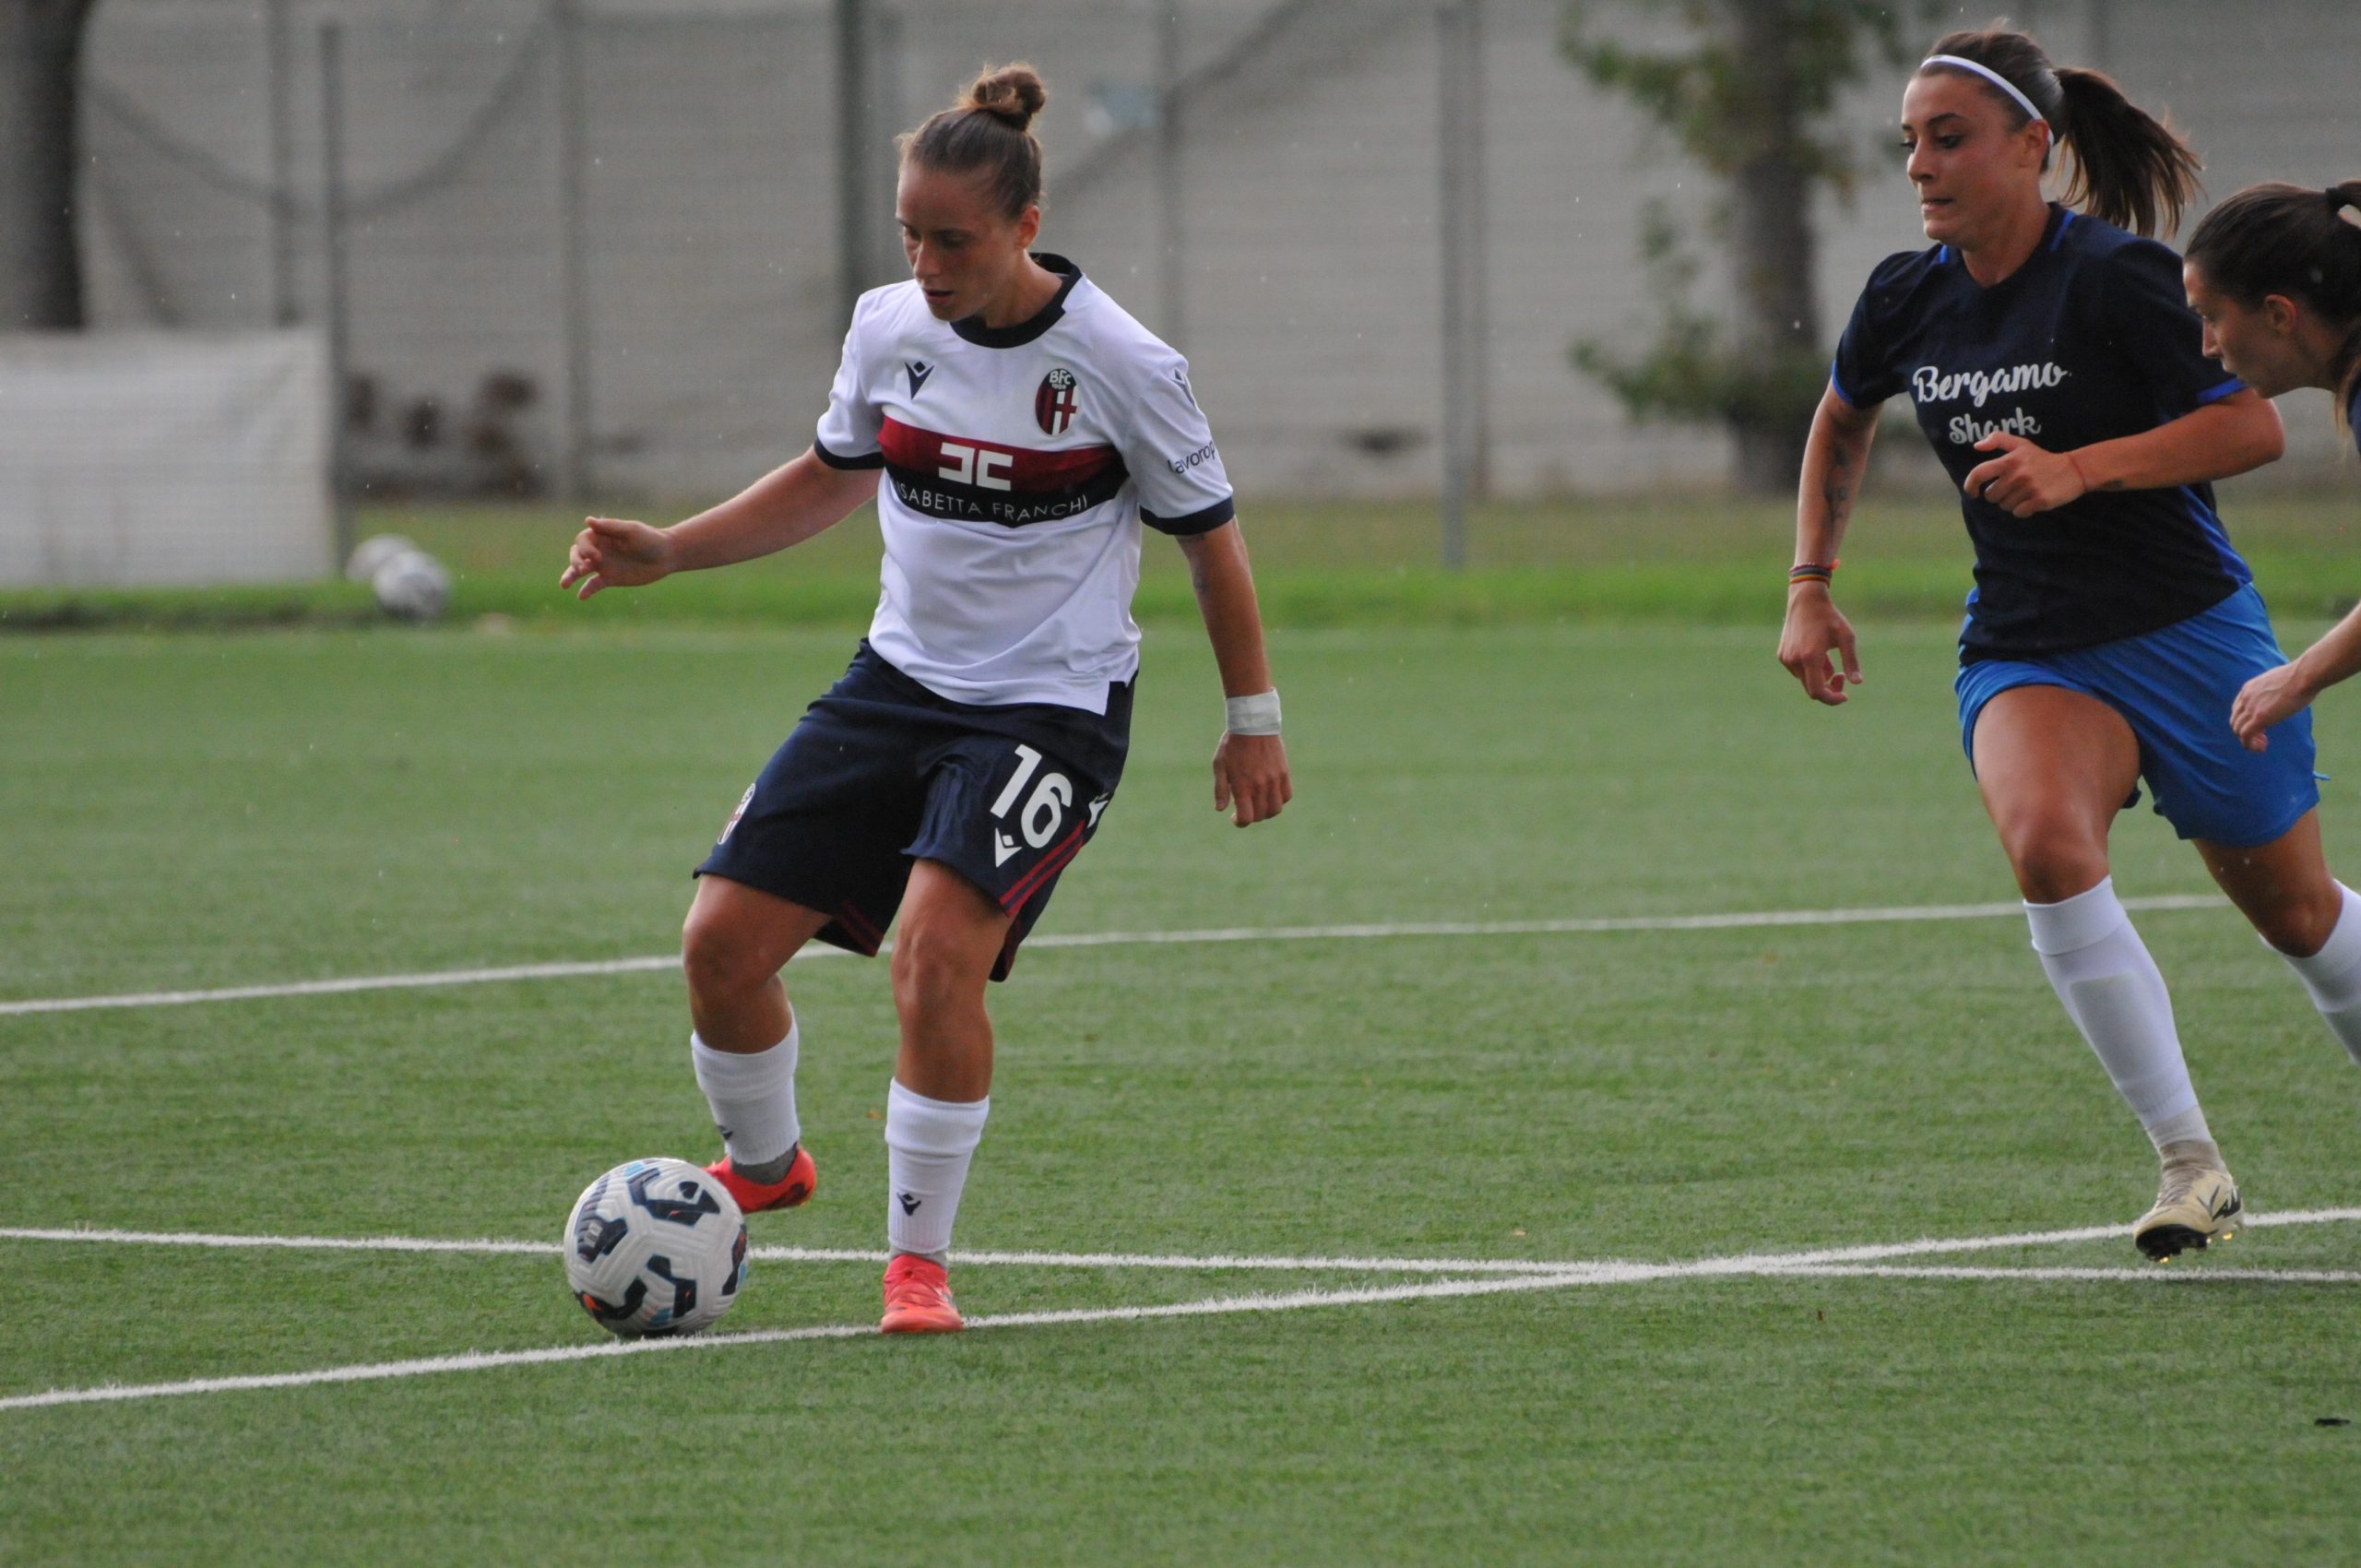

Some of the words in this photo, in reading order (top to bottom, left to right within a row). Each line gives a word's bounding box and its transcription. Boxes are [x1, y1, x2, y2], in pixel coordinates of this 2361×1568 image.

[1050, 370, 1072, 385] BFC
[1913, 362, 2068, 408] Bergamo
[992, 494, 1087, 521] FRANCHI
[991, 744, 1073, 848] 16
